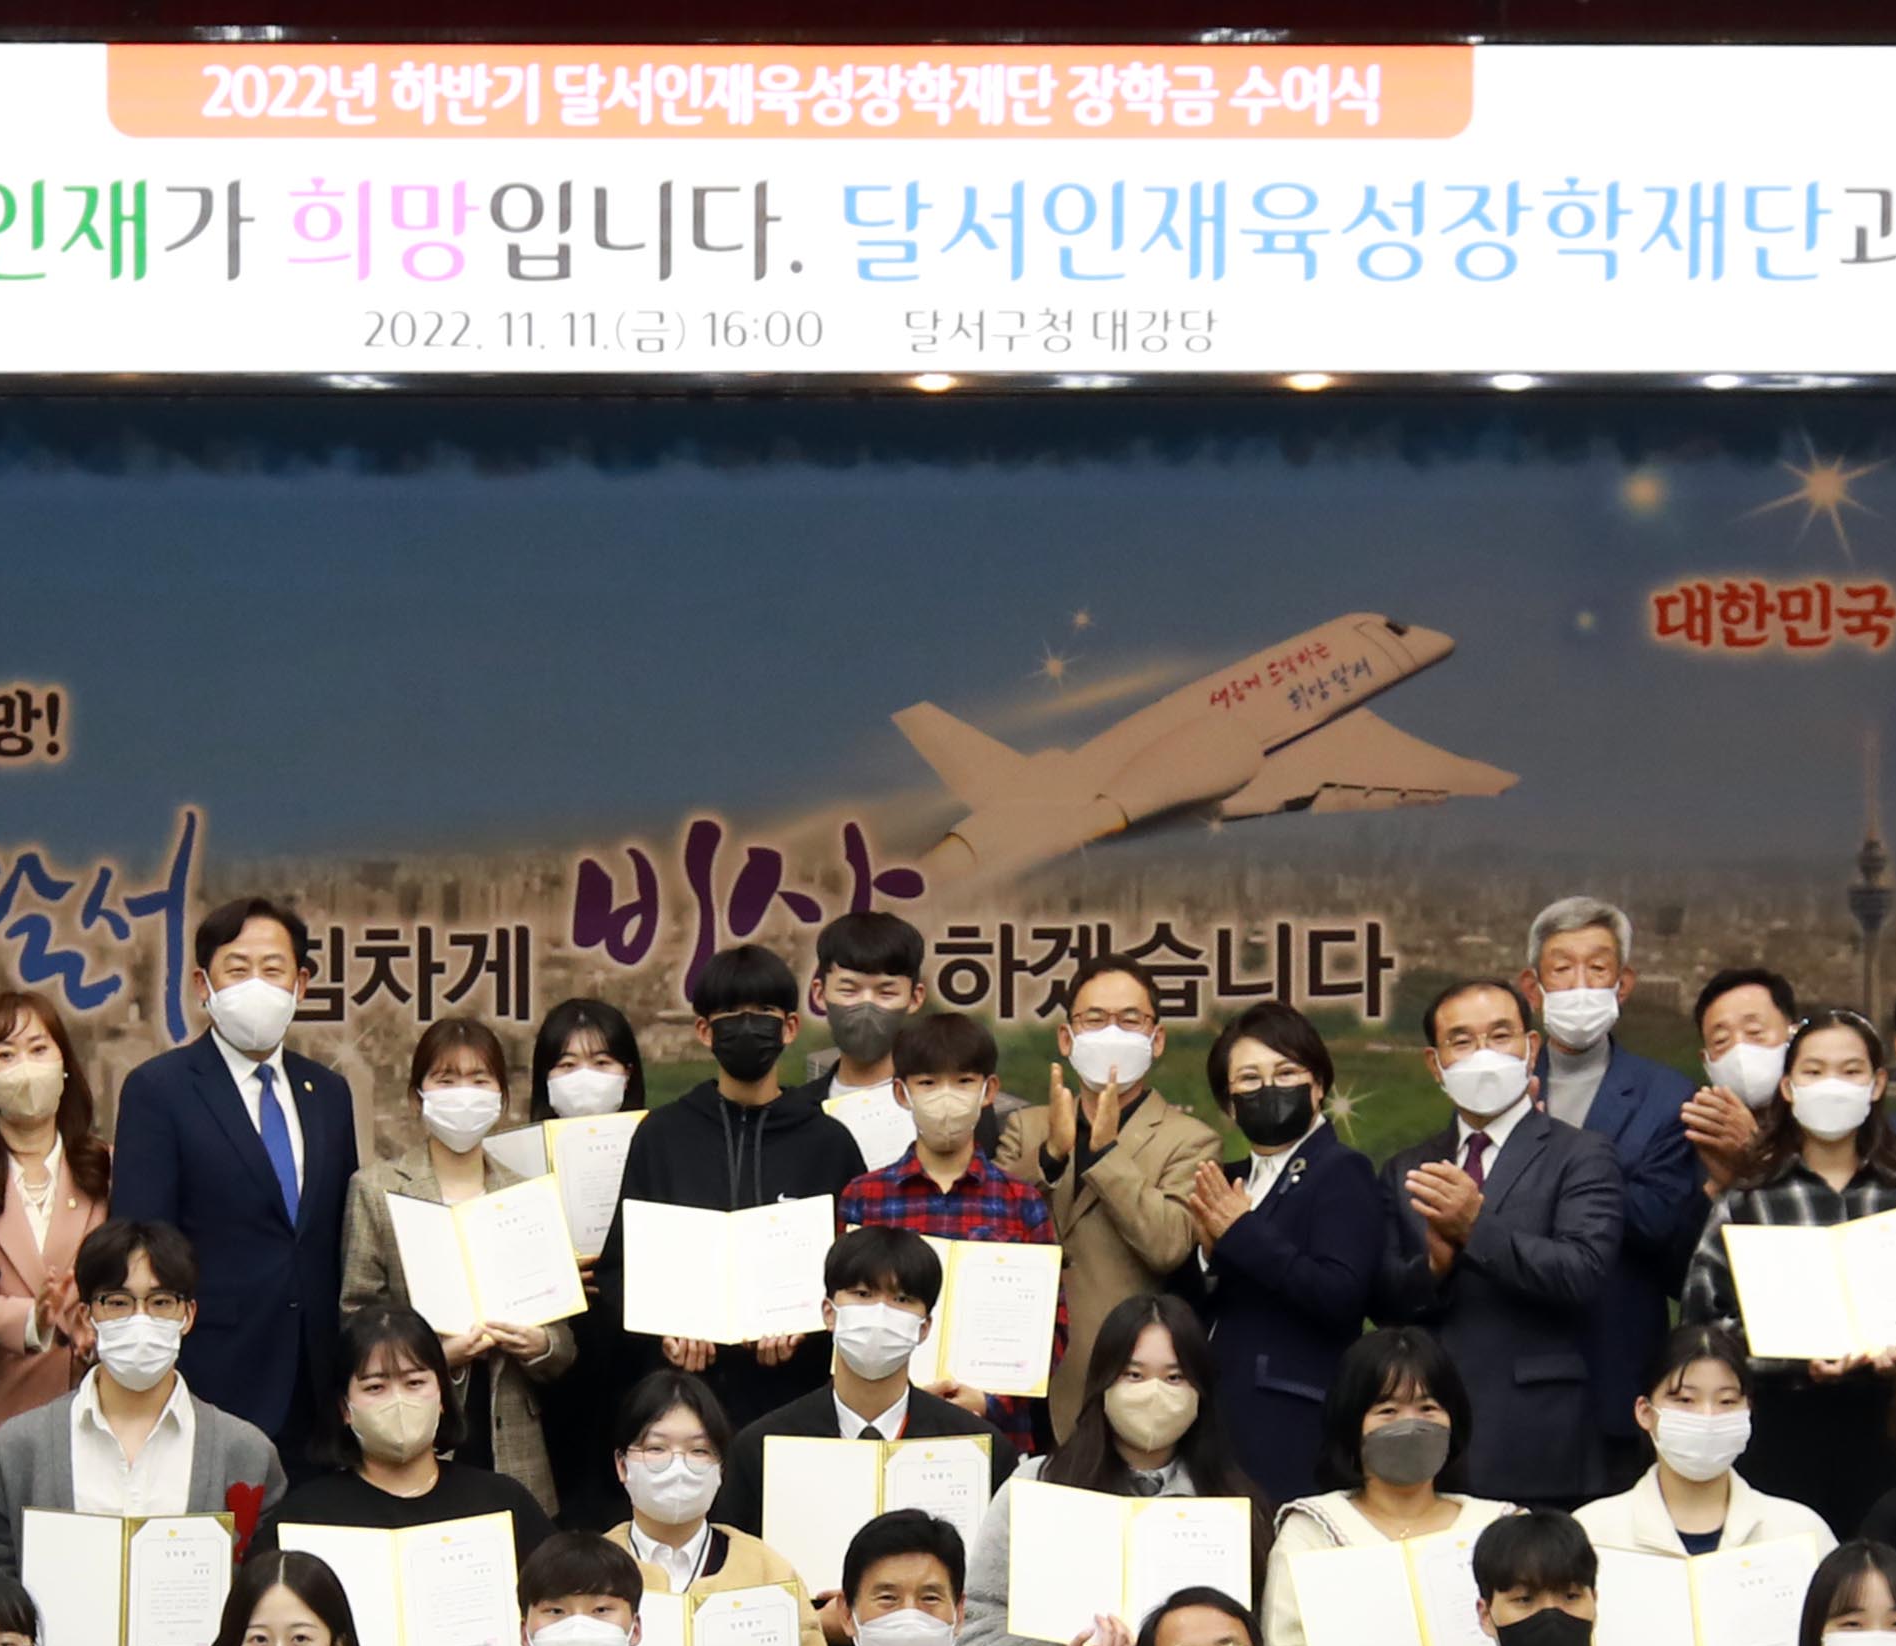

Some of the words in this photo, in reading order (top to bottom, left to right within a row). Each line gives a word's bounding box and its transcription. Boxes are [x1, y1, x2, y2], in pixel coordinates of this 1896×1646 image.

[201, 63, 377, 127] 2022년
[390, 63, 541, 128] 하반기
[553, 63, 1057, 128] 달서인재육성장학재단
[1066, 63, 1220, 128] 장학금
[1229, 63, 1381, 128] 수여식
[287, 177, 804, 282] 희망입니다.
[363, 310, 484, 352] 2022.
[498, 310, 547, 351] 11.
[563, 309, 688, 354] 11.(금)
[704, 310, 824, 348] 16:00
[904, 307, 1075, 355] 달서구청
[1092, 307, 1219, 355] 대강당
